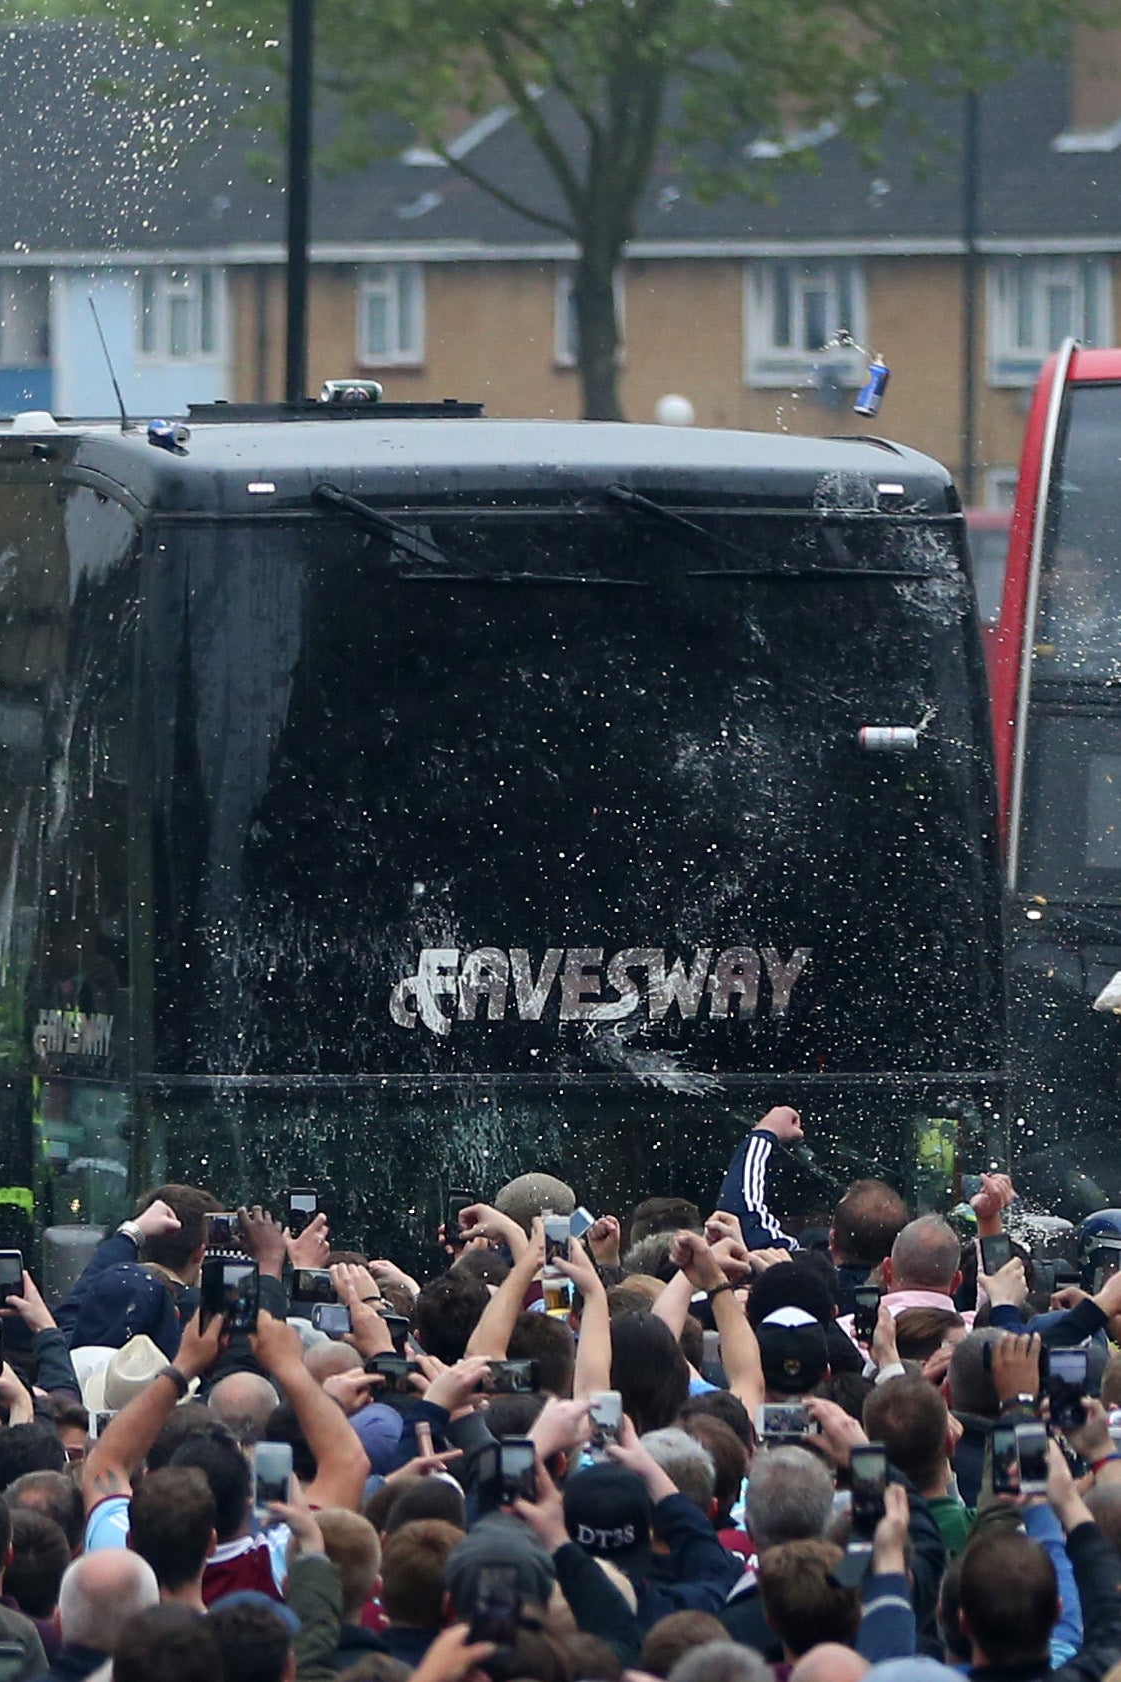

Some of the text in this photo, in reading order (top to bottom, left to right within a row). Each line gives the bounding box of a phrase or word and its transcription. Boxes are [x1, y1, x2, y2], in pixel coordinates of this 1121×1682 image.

[389, 947, 813, 1037] EAVESWAY
[557, 1020, 787, 1038] EXCLUSIVE
[576, 1524, 635, 1549] DT38
